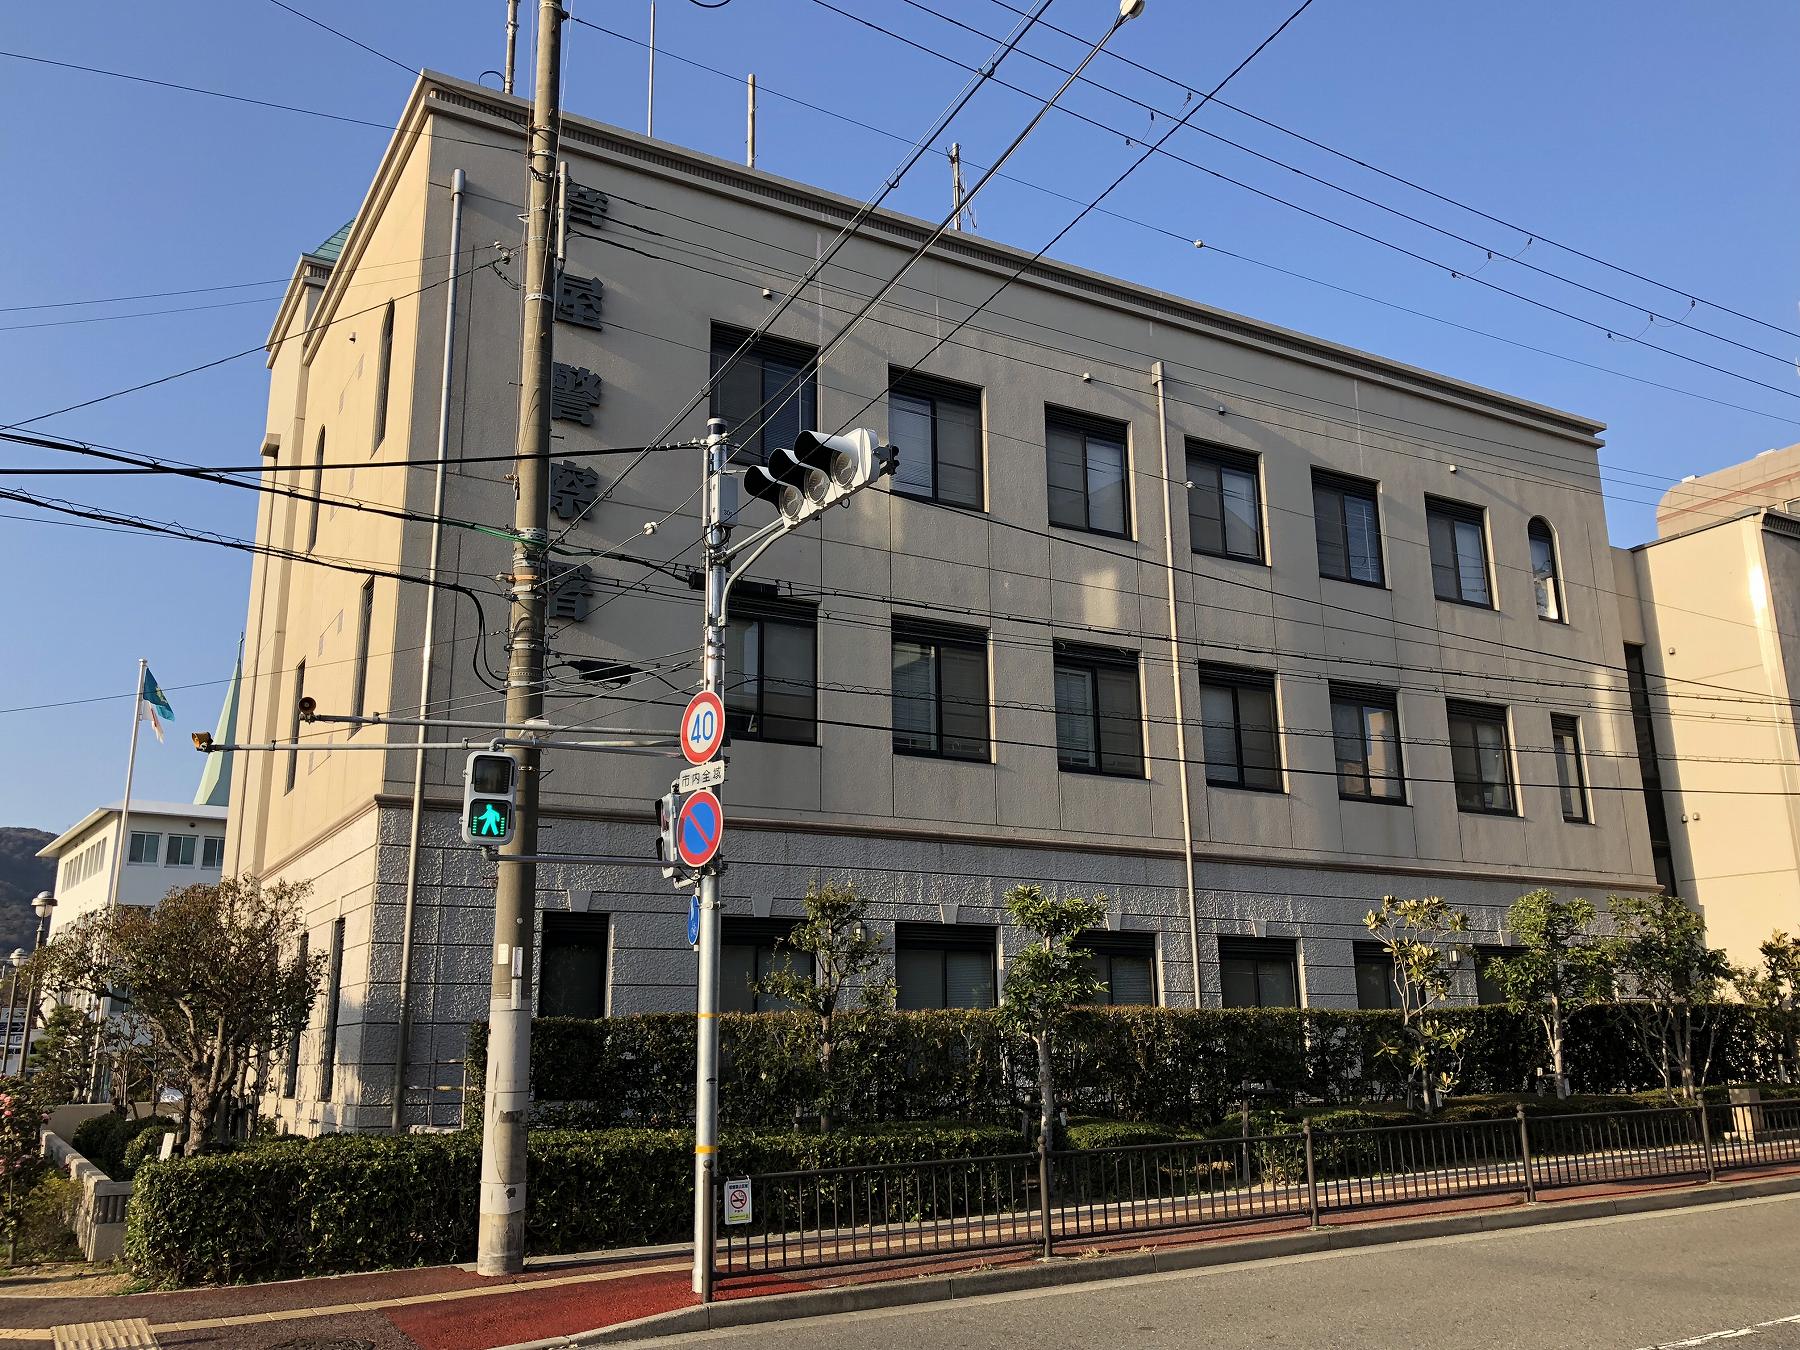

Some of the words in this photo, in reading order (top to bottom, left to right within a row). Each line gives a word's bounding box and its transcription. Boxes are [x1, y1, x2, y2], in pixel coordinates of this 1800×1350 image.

[691, 710, 714, 743] 40
[682, 767, 721, 787] 市内全域
